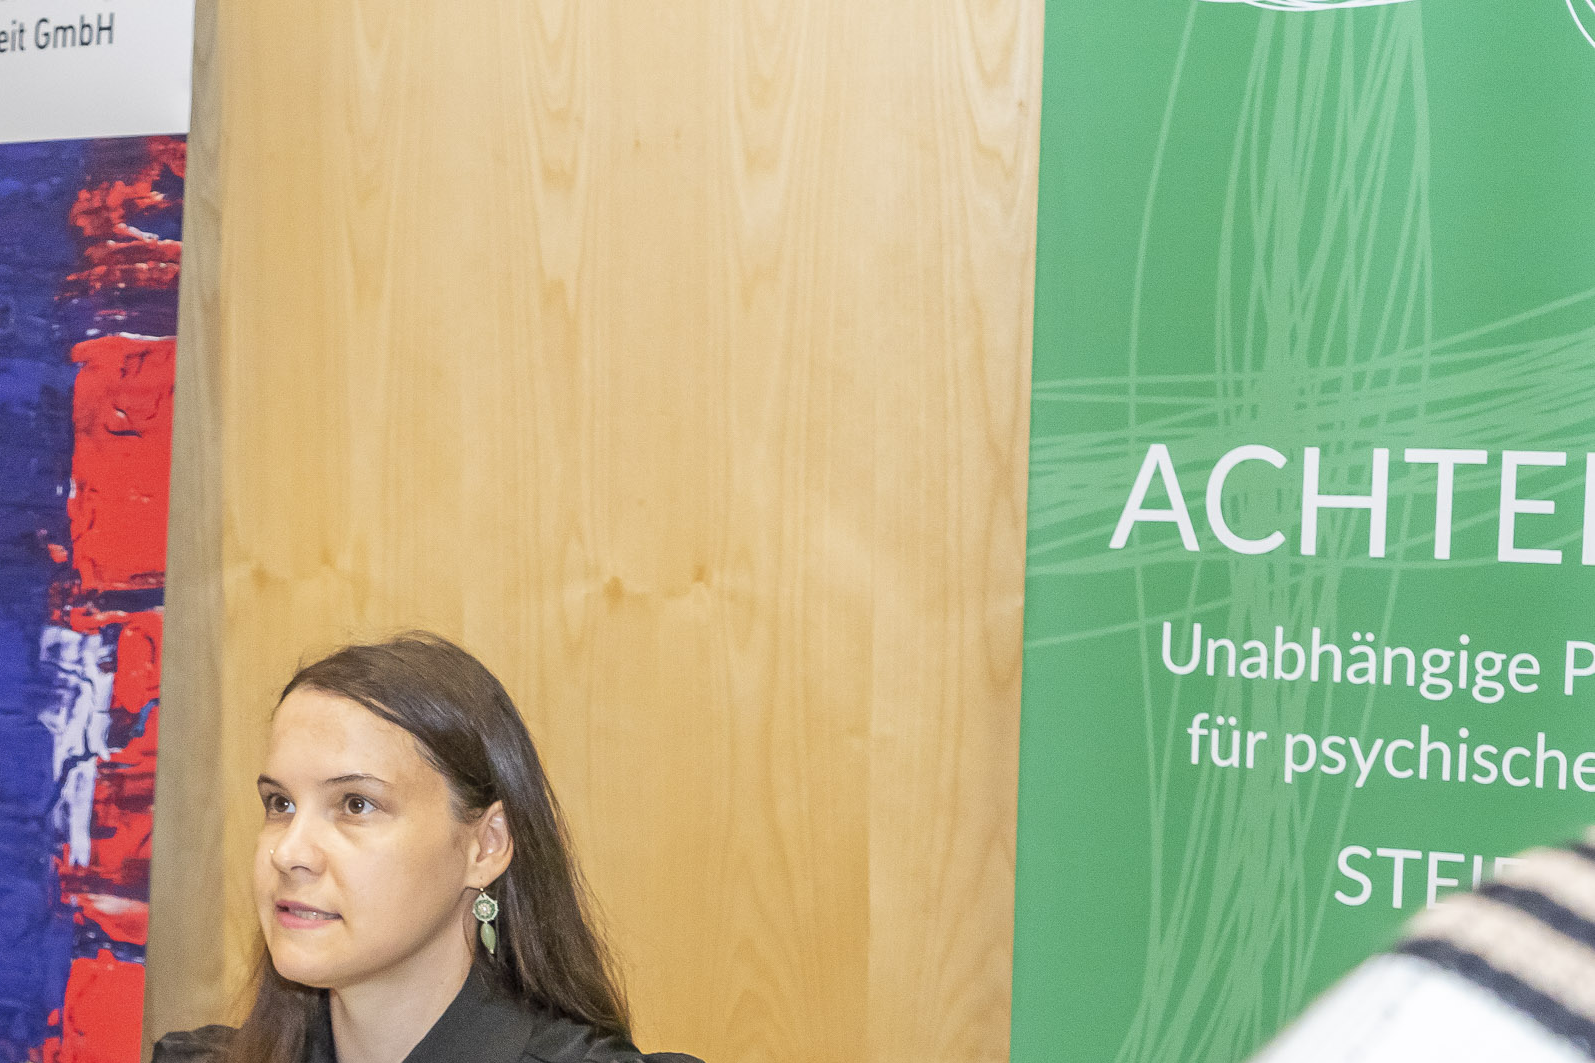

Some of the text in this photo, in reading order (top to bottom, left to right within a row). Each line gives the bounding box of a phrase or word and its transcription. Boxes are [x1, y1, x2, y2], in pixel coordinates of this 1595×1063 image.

[34, 12, 115, 50] GmbH
[1108, 443, 1595, 566] ACHTE
[1161, 621, 1540, 703] Unabhängige
[1187, 713, 1268, 769] für
